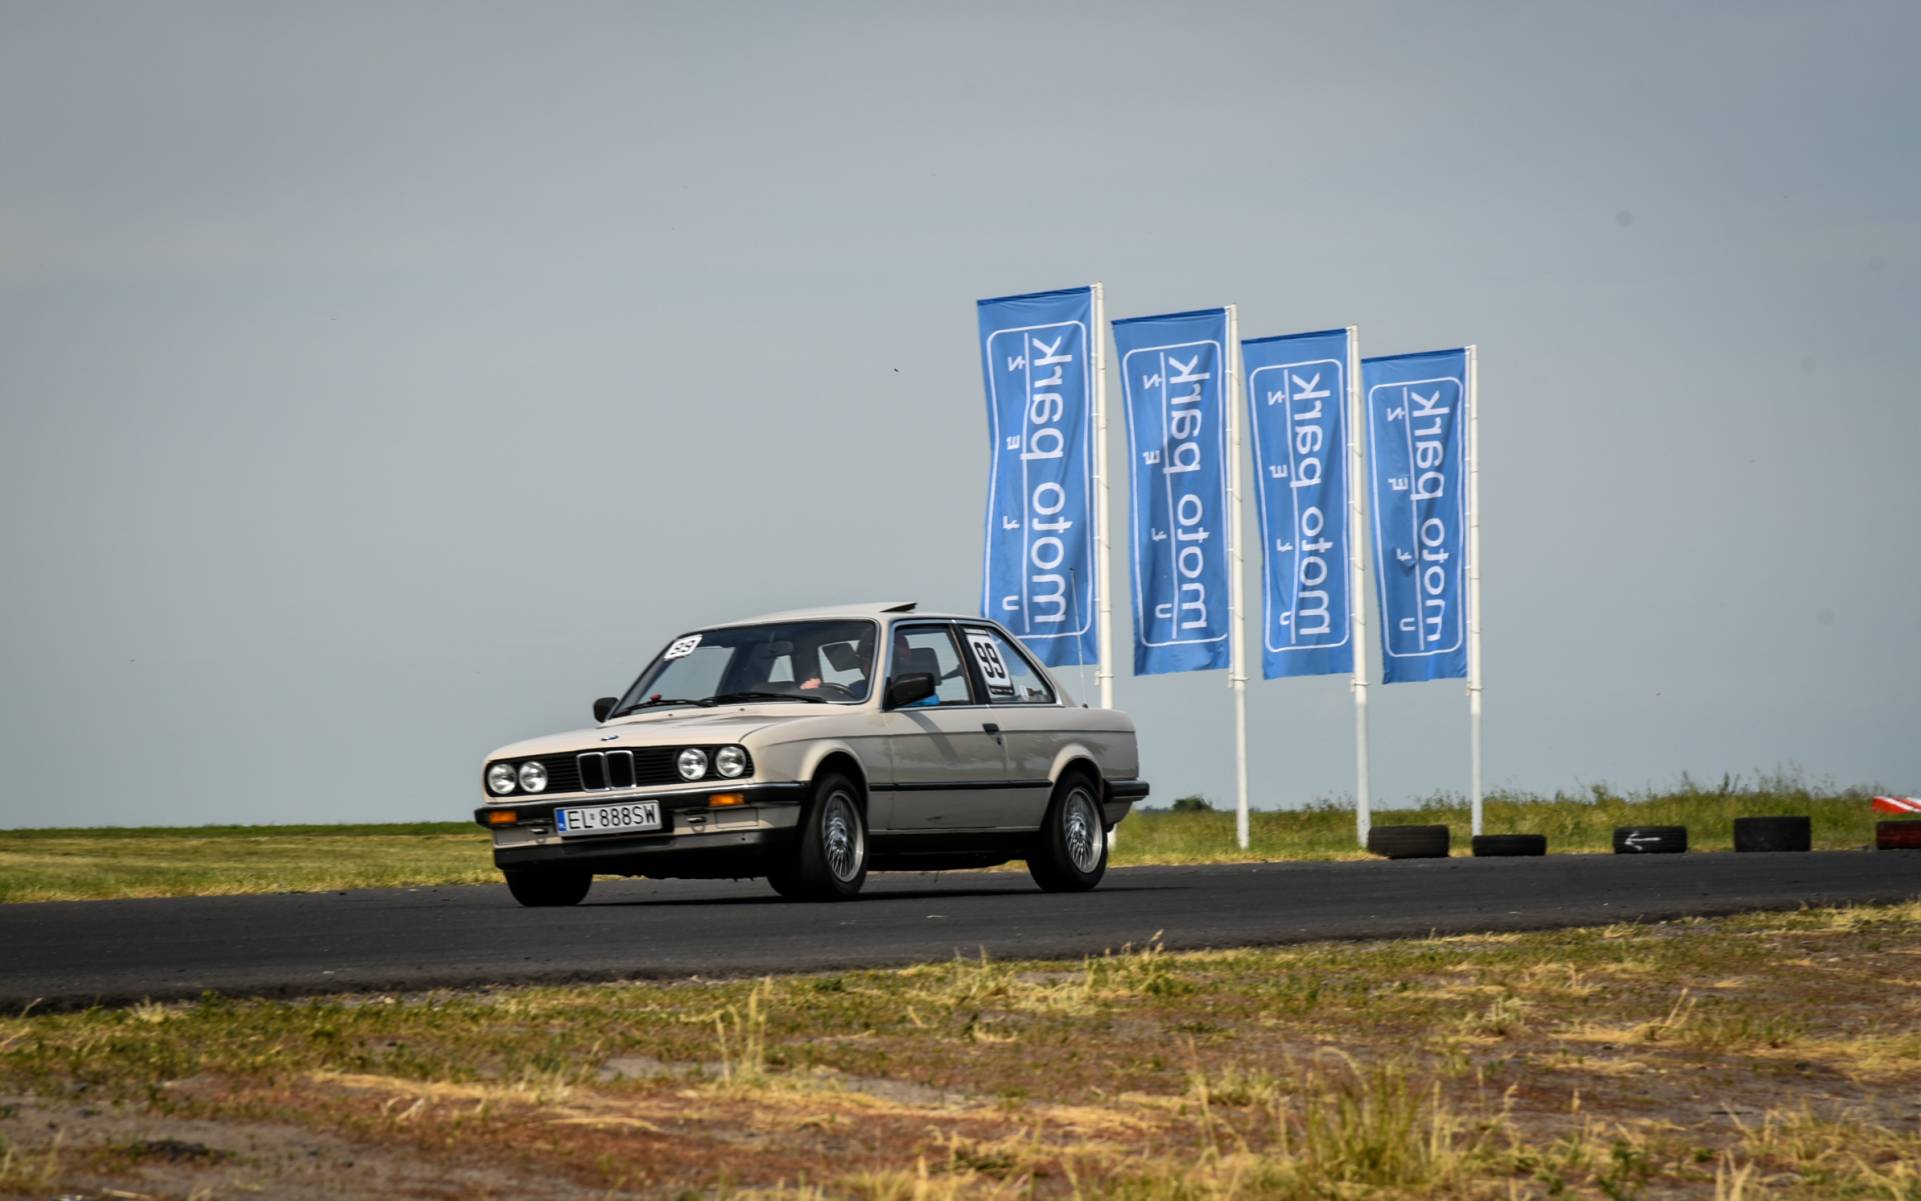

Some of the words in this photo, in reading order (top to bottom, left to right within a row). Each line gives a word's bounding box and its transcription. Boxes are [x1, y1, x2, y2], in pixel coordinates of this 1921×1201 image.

[973, 641, 1006, 679] 99
[567, 810, 593, 830] EL
[600, 804, 656, 827] 888SW
